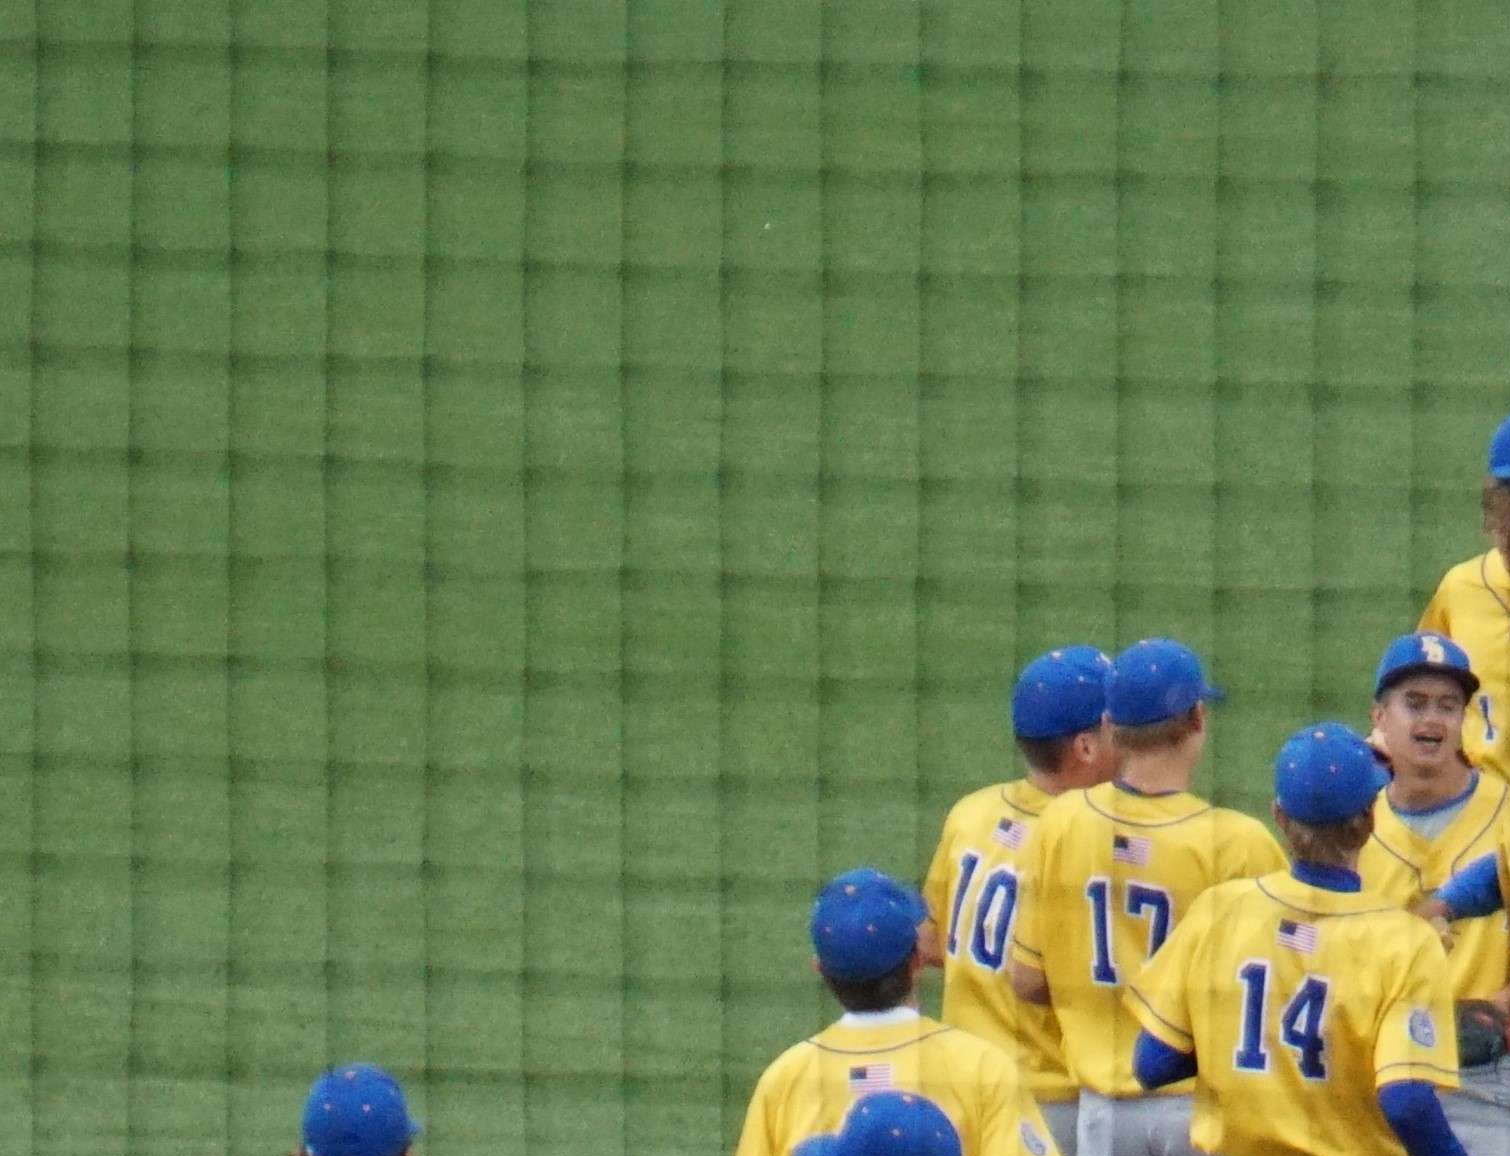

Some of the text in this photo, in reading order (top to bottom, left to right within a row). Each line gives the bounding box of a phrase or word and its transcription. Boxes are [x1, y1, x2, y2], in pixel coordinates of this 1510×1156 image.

[946, 852, 1020, 970] 10
[1084, 878, 1172, 986] 17
[1235, 959, 1330, 1080] 14
